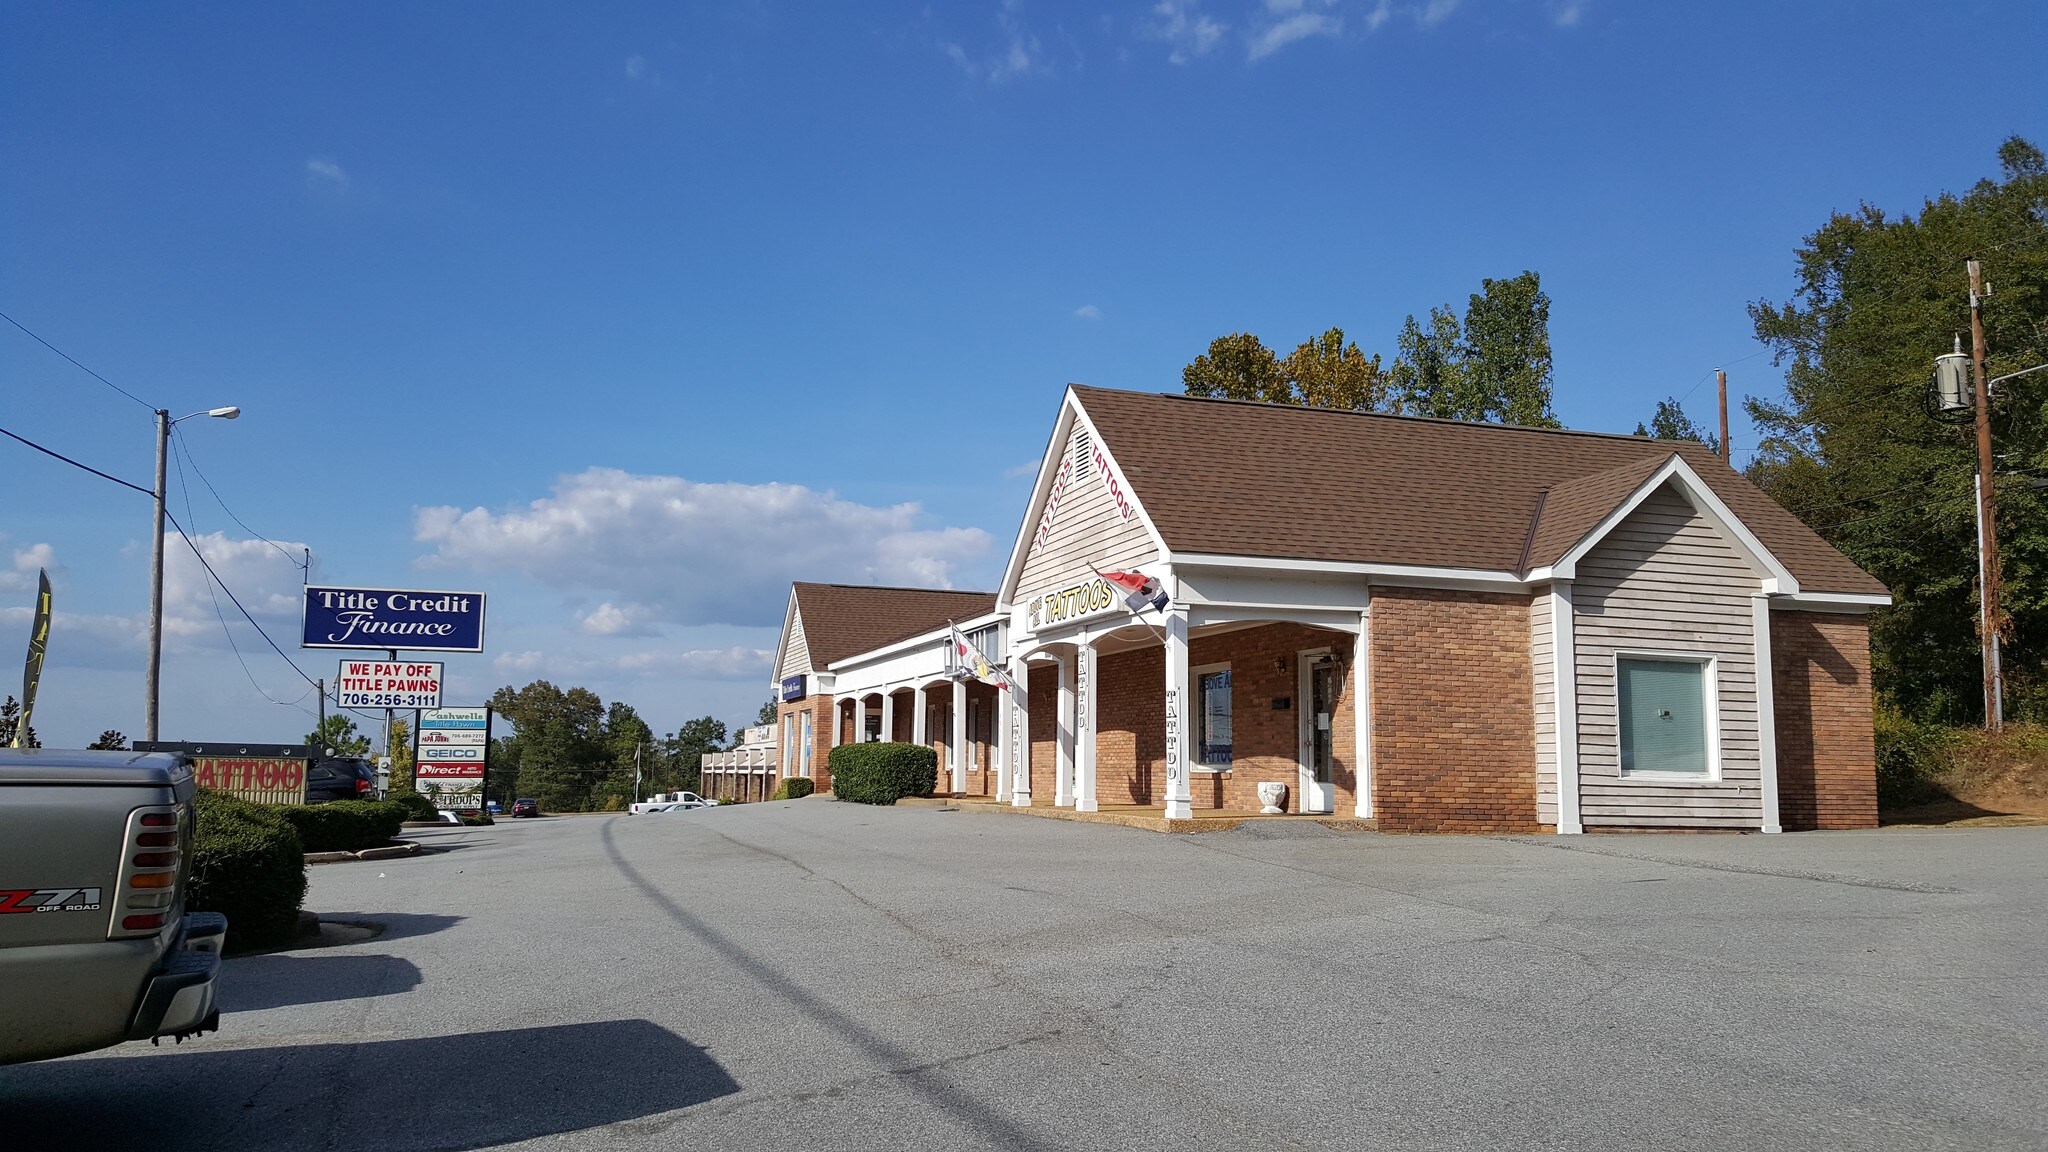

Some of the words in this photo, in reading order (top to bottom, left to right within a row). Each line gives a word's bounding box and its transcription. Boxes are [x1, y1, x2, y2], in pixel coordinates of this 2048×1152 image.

[1092, 443, 1130, 520] TATTOOS
[1037, 459, 1071, 548] TATTOOS
[318, 591, 379, 610] Title
[387, 594, 470, 613] Credit
[1045, 578, 1113, 624] TATTOOS
[327, 611, 458, 642] Finance
[349, 663, 370, 676] WE
[374, 664, 402, 677] PAY
[406, 664, 433, 677] OFF
[343, 678, 383, 691] TITLE
[387, 679, 439, 692] PAWNS
[1078, 650, 1087, 728] TATTOO
[343, 693, 436, 706] 706-256-3111
[423, 710, 483, 723] Cashwells
[1012, 706, 1020, 775] TATTOO
[1166, 690, 1177, 780] TATTOO
[426, 749, 477, 757] GEICO
[195, 760, 303, 789] ATTOO
[419, 765, 461, 774] Direct
[0, 887, 101, 914] Z71
